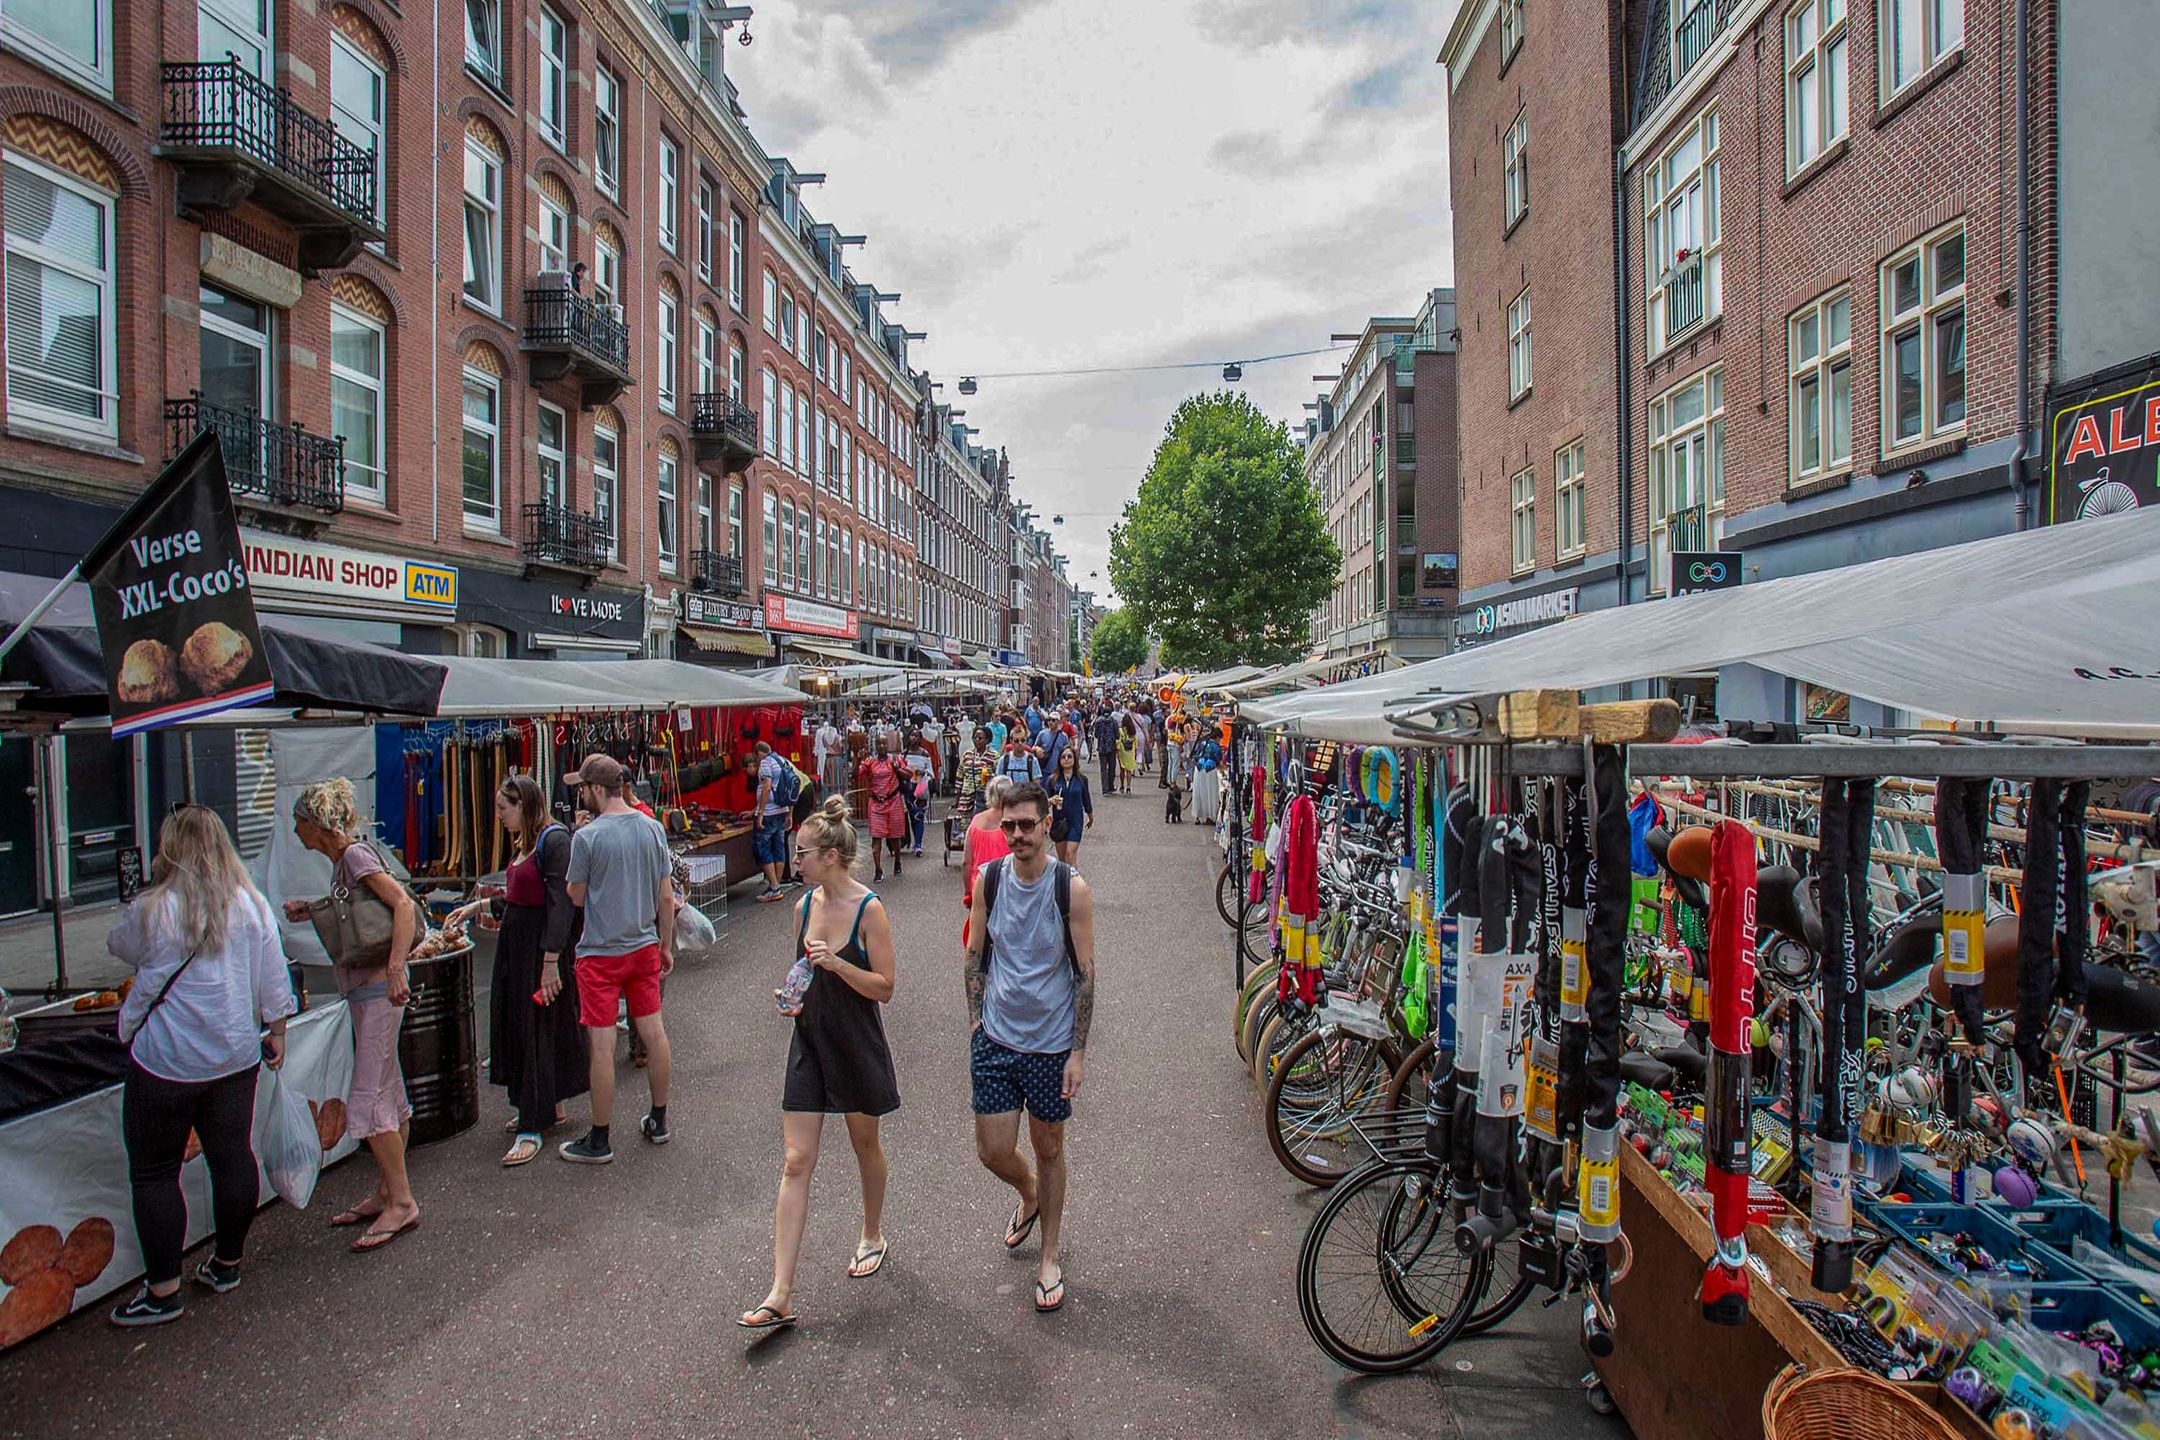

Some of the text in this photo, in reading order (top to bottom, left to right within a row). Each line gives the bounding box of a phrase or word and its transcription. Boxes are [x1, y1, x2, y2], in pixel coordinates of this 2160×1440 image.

[130, 529, 202, 569] Verse
[246, 545, 398, 590] INDIAN SHOP
[413, 573, 449, 598] ATM
[590, 601, 622, 621] MODE
[731, 606, 751, 621] BRAND
[1495, 599, 1526, 628] ASIAN
[1526, 586, 1579, 622] MARKET
[1505, 963, 1532, 975] AXA
